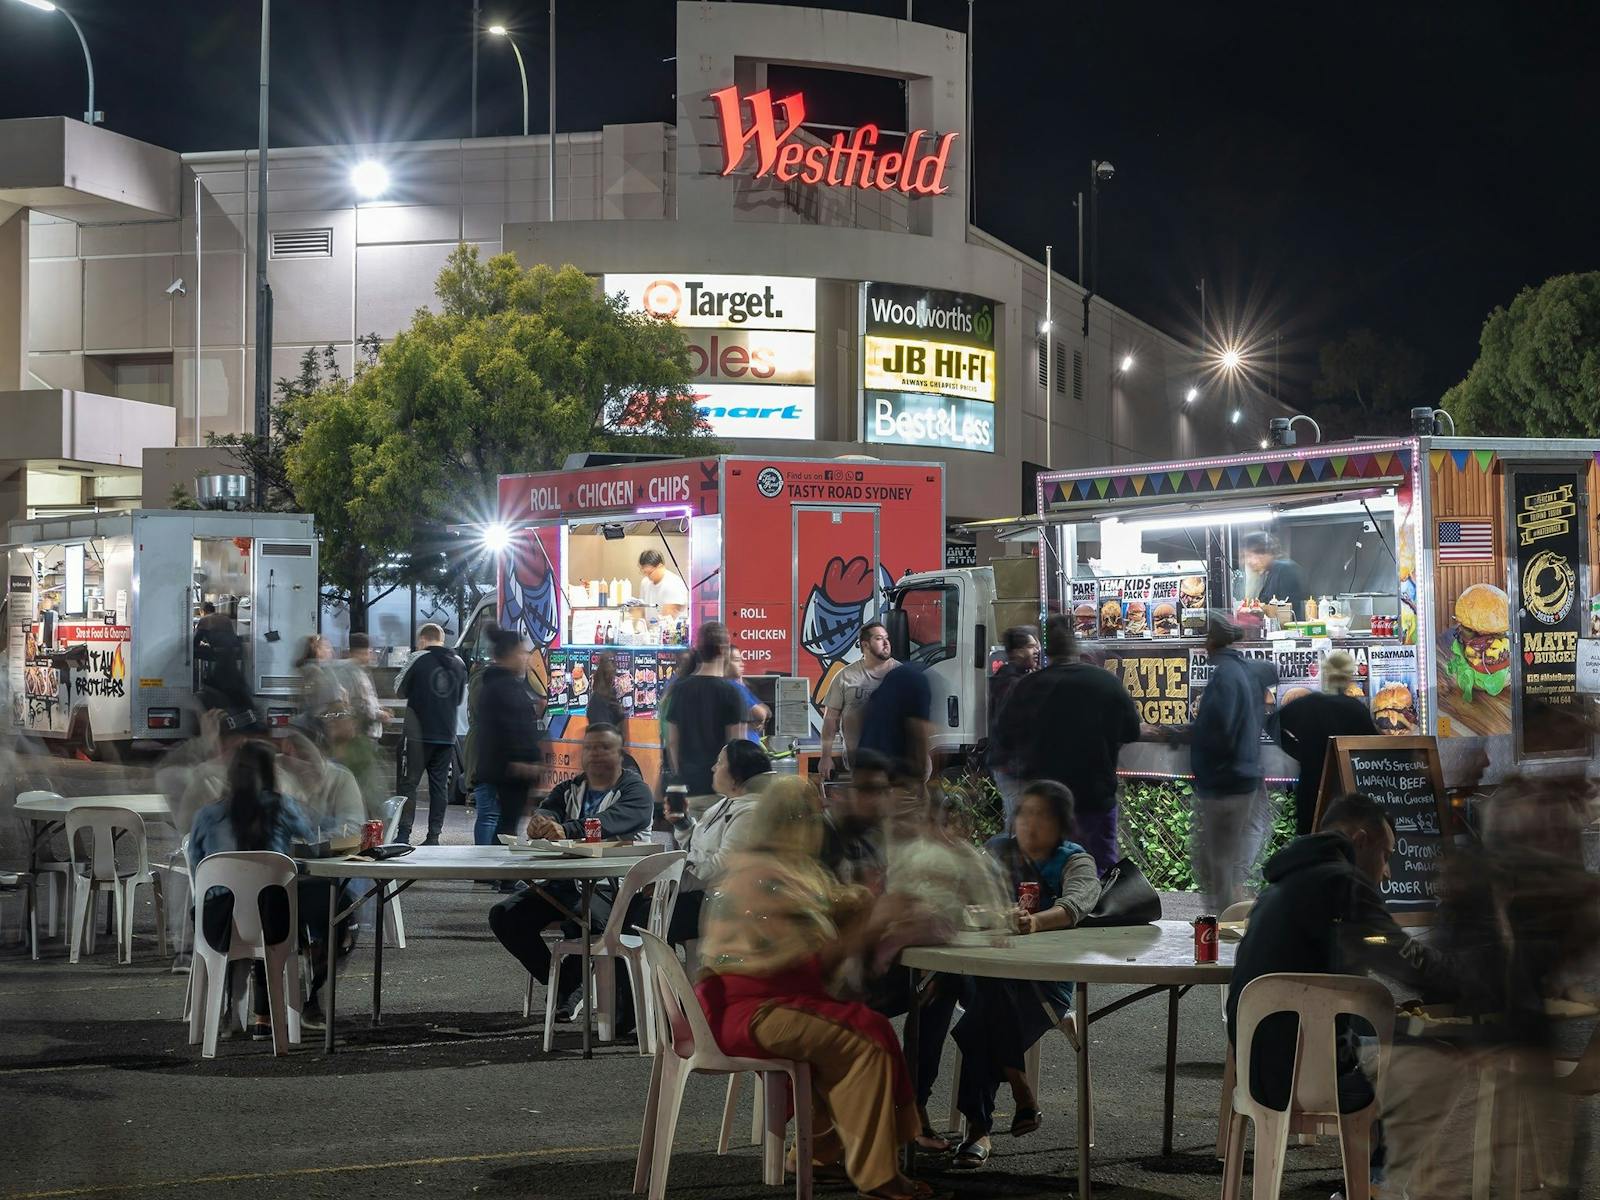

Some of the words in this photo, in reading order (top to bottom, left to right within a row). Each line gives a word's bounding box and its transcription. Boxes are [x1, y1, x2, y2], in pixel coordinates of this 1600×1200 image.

[710, 85, 959, 194] Westfield
[871, 298, 972, 333] Woolworths
[686, 336, 776, 379] oles
[883, 345, 926, 375] JB
[901, 378, 928, 388] ALWAYS
[929, 381, 959, 391] CHEAPEST
[787, 472, 802, 480] Find
[530, 487, 561, 511] ROLL
[577, 480, 634, 508] CHICKEN
[649, 475, 690, 503] CHIPS
[787, 484, 825, 499] TASTY
[828, 486, 862, 500] ROAD
[865, 487, 912, 501] SYDNEY
[1072, 583, 1095, 595] PARE
[1124, 579, 1151, 590] KIDS
[1153, 581, 1178, 590] CHEESE
[1123, 590, 1143, 600] PACK
[1152, 589, 1172, 599] MATE
[740, 608, 767, 619] ROLL
[76, 627, 90, 638] Street
[90, 627, 104, 638] Food
[105, 627, 109, 638] &
[740, 629, 786, 640] CHICKEN
[1523, 631, 1578, 652] MATE
[741, 650, 772, 660] CHIPS
[1279, 652, 1318, 665] CHEESE
[1371, 650, 1415, 659] ENSAYMADA
[1279, 664, 1309, 678] MATE
[75, 677, 125, 698] BROTHERS
[1526, 685, 1575, 694] MateBurger.com.a
[1135, 700, 1189, 725] RGER
[1363, 774, 1398, 789] WAGYU
[1400, 776, 1426, 791] BEEF
